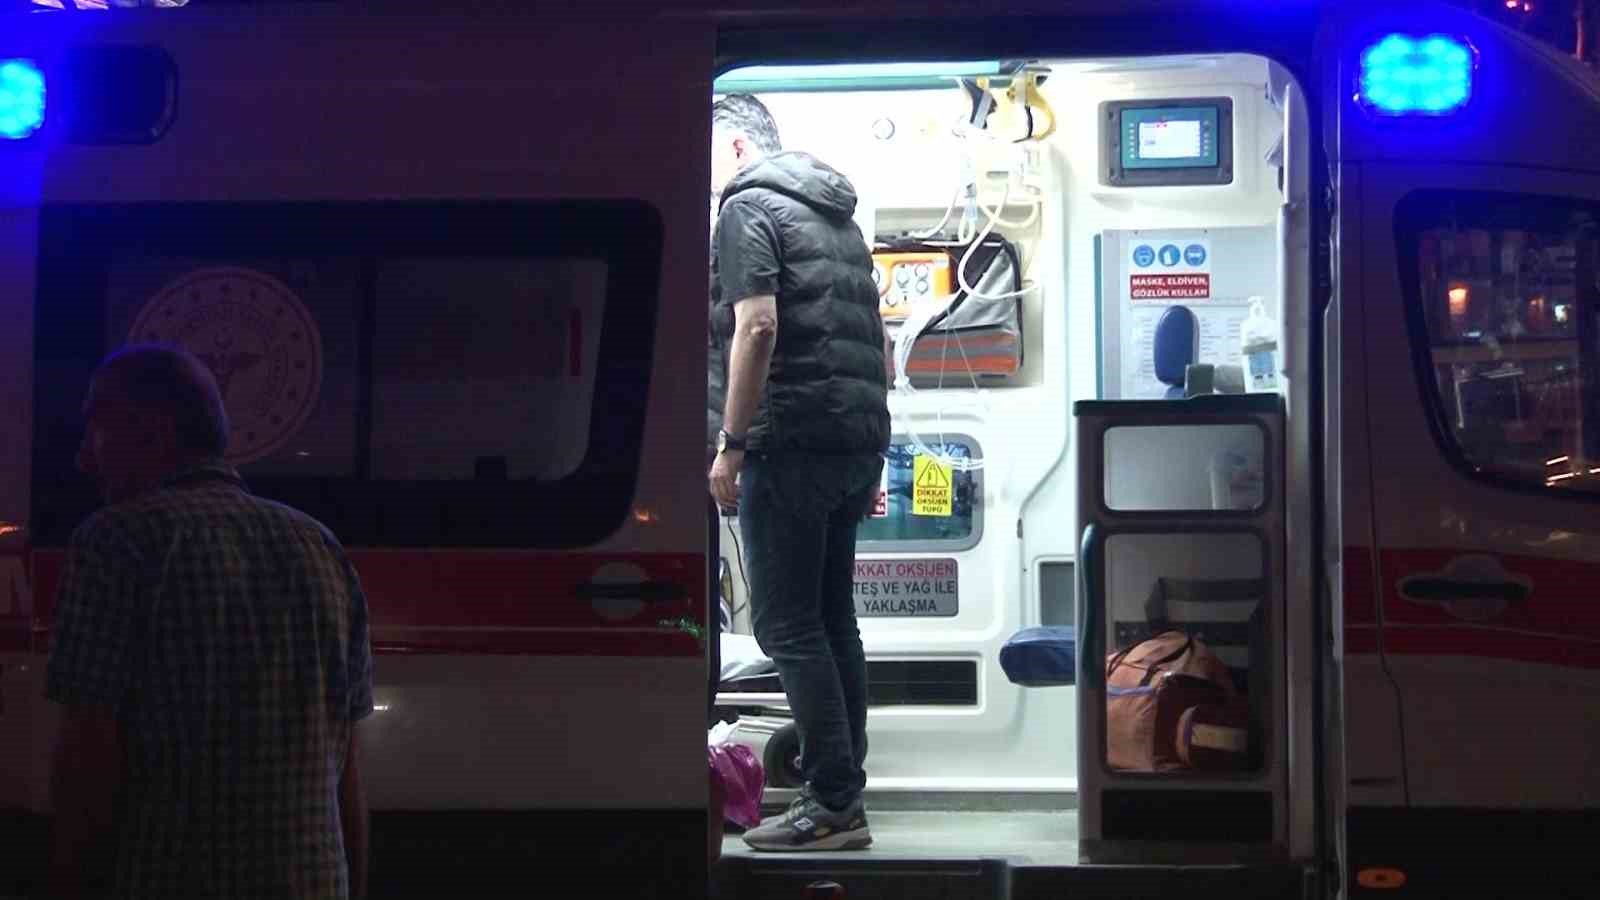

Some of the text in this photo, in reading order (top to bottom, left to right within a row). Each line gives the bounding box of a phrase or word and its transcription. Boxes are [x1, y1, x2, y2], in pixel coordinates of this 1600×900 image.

[1131, 277, 1166, 287] MASKE,
[1171, 288, 1208, 297] KULLAN
[857, 562, 891, 577] KKAT
[853, 578, 955, 597] TEŞ VE YAĞ İLE
[863, 599, 937, 616] YAKLAŞMA
